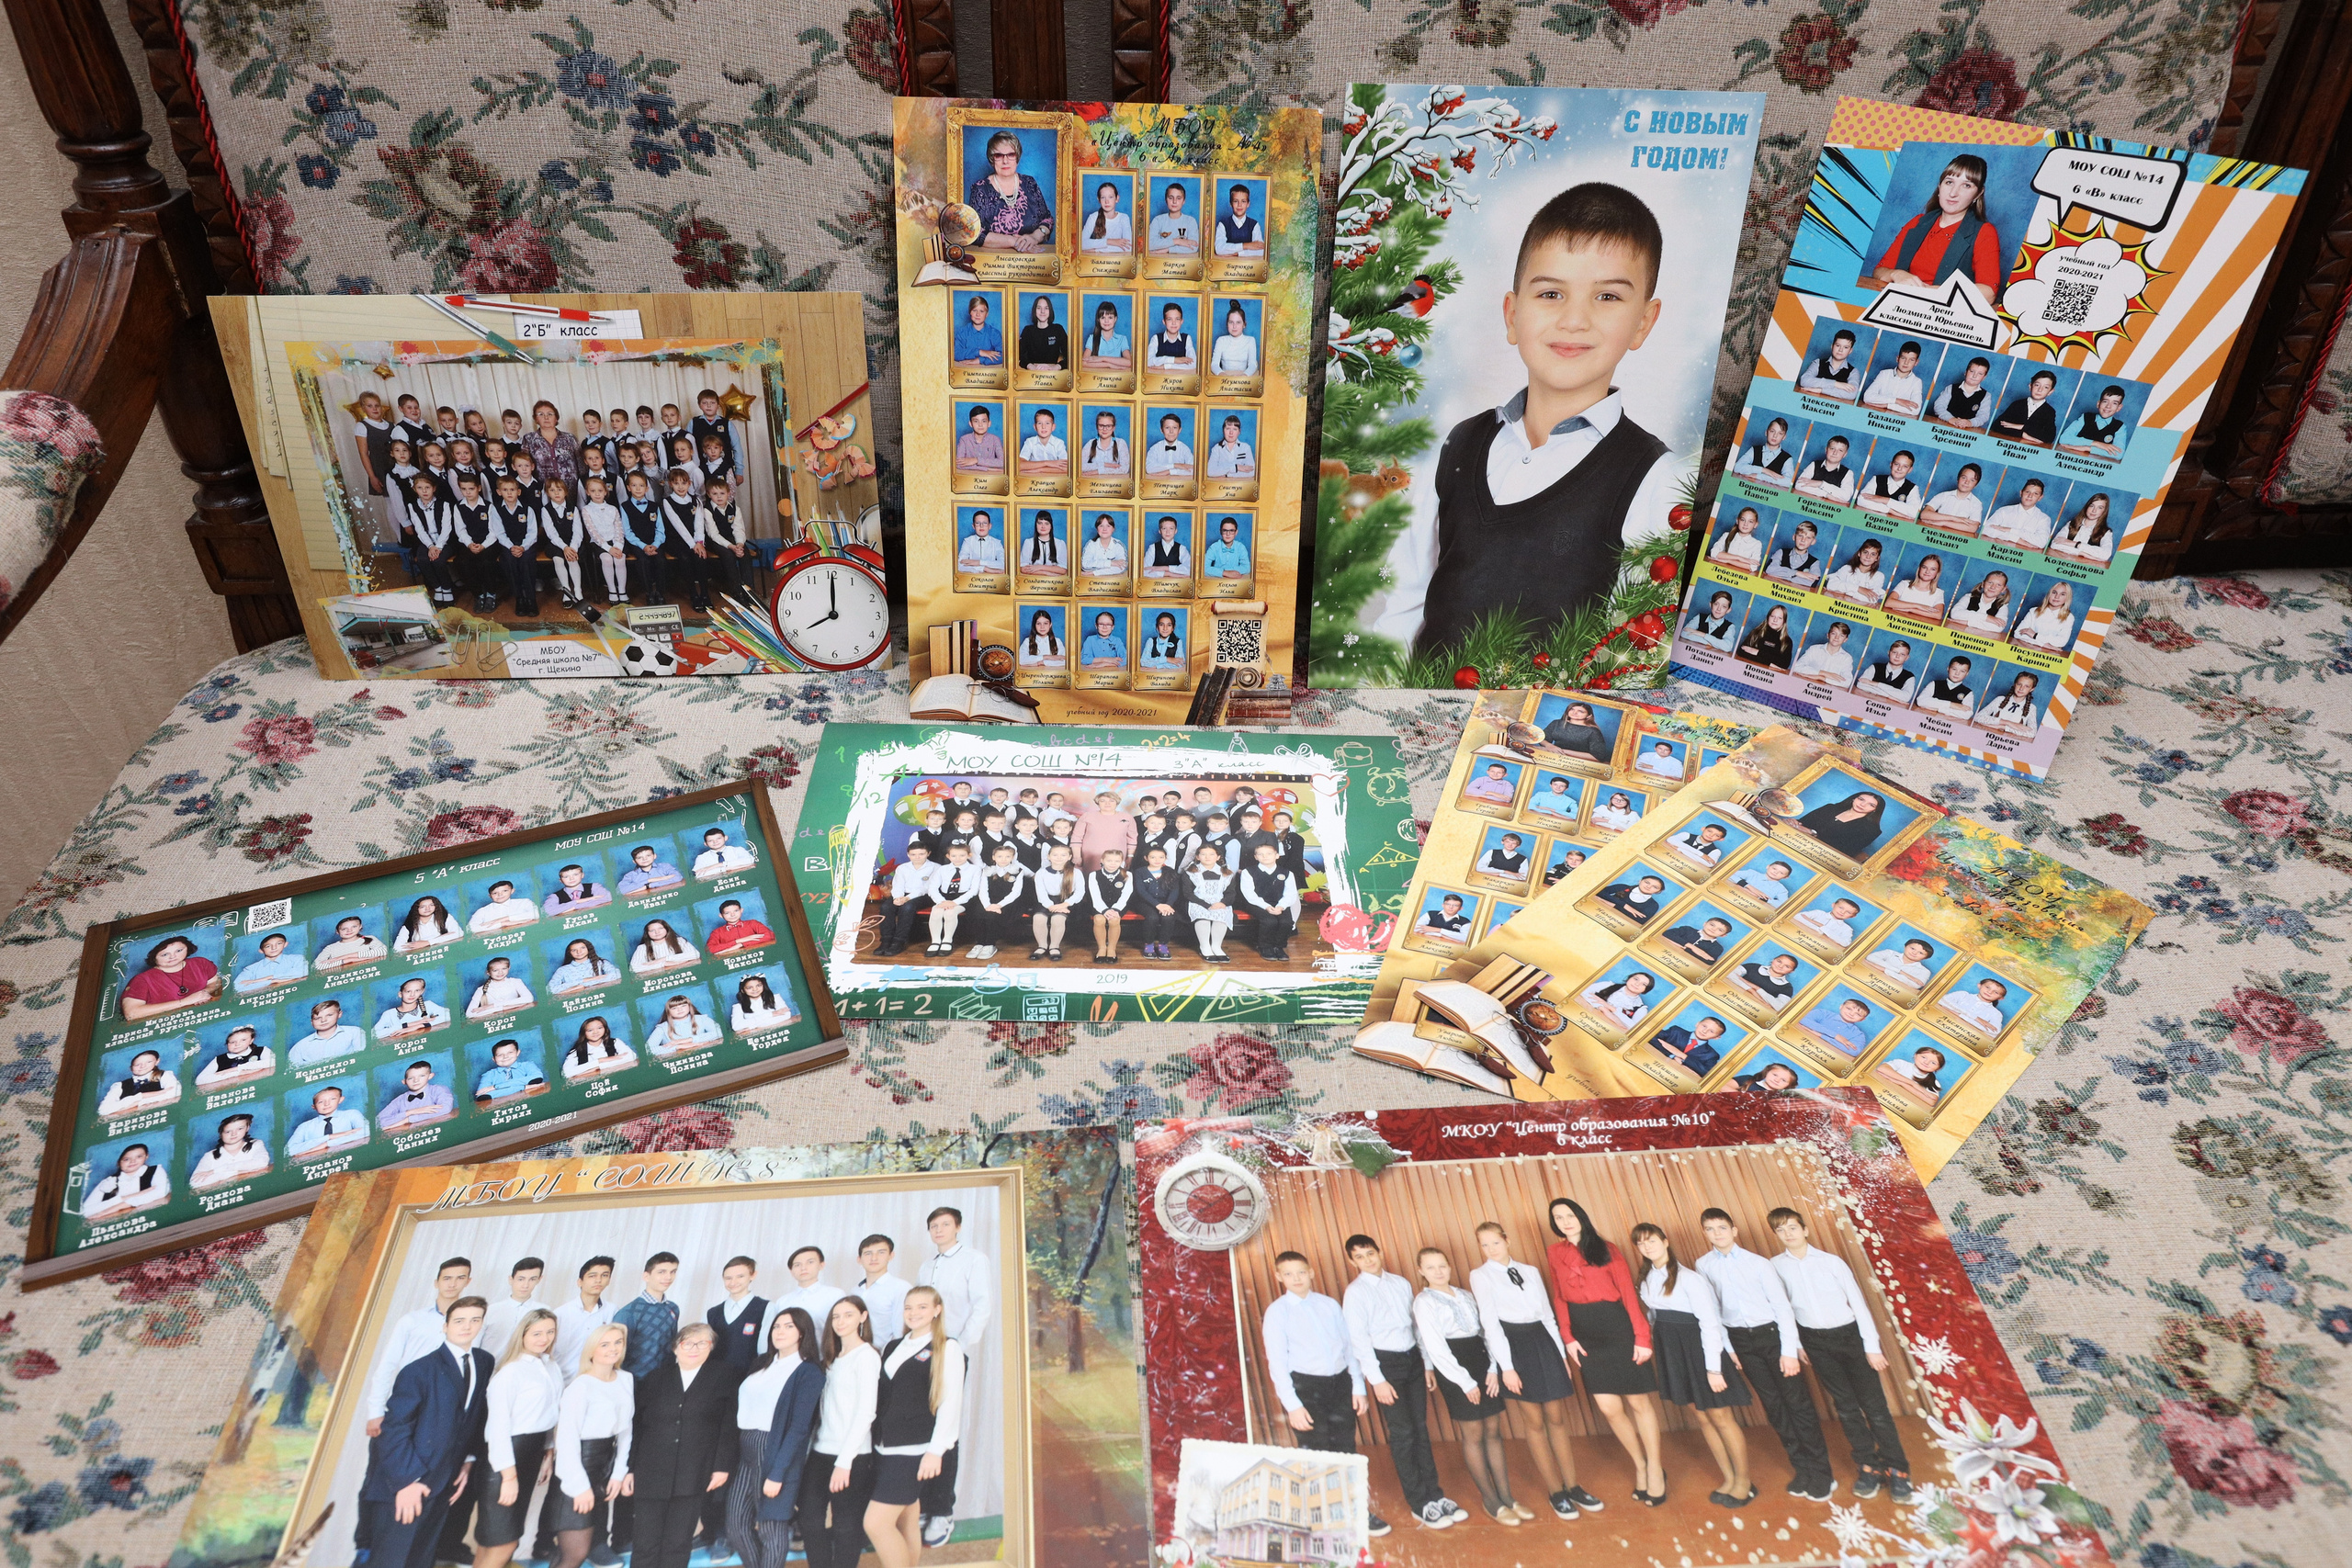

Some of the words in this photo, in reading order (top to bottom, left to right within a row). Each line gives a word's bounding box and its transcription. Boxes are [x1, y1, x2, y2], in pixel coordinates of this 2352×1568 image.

[1147, 117, 1216, 135] МБОУ
[1624, 110, 1640, 132] С
[1649, 111, 1748, 135] НОВЫМ
[1148, 136, 1222, 152] образования
[1139, 152, 1146, 163] 6
[1631, 146, 1728, 171] ГОДОМ!
[2069, 161, 2097, 173] МОУ
[2100, 165, 2131, 179] СОШ
[2133, 171, 2164, 185] №14
[2073, 185, 2081, 194] 6
[2086, 187, 2106, 198] «В»
[2109, 193, 2143, 205] класс
[2060, 255, 2095, 266] учебный
[2097, 262, 2111, 270] год
[2058, 265, 2104, 280] 2020-2021
[1893, 305, 1932, 320] Людмила
[1935, 317, 1974, 331] Юрьевна
[1929, 305, 1954, 316] Арент
[560, 326, 597, 336] класс
[1879, 312, 1922, 327] классный
[1925, 324, 1984, 343] руководитель
[1801, 396, 1840, 410] Алексеев
[1802, 403, 1835, 416] Максим
[1868, 412, 1905, 425] Балашов
[1868, 420, 1901, 433] Никита
[1931, 426, 1977, 443] Барбашин
[1932, 434, 1971, 448] Арсений
[1996, 440, 2039, 455] Барыкин
[2003, 450, 2027, 460] Иван
[2055, 452, 2112, 470] Виндовский
[2056, 462, 2105, 478] Александр
[1738, 480, 1779, 497] Воронцов
[1744, 490, 1769, 502] Павел
[1797, 496, 1841, 513] Гореленко
[1800, 504, 1834, 519] Максим
[1864, 513, 1899, 527] Горелов
[1865, 522, 1893, 534] Вадим
[1921, 527, 1969, 544] Емельянов
[1926, 536, 1959, 549] Михаил
[1991, 544, 2024, 557] Карлов
[1986, 552, 2022, 565] Максим
[2044, 557, 2105, 576] Колесникова
[2056, 568, 2087, 580] Софья
[807, 576, 817, 584] 11
[850, 578, 854, 586] 1
[790, 592, 801, 600] 10
[869, 594, 875, 603] 2
[785, 609, 791, 617] 9
[876, 612, 881, 620] 3
[1884, 615, 1934, 631] Муковнина
[1886, 622, 1928, 637] Ангелина
[1951, 631, 1995, 648] Пименова
[1952, 639, 1986, 653] Марина
[540, 647, 566, 655] МБОУ
[831, 650, 838, 659] 6
[854, 646, 859, 654] 5
[2010, 646, 2063, 664] Посулихина
[548, 665, 582, 673] Щекино
[2017, 655, 2051, 669] Карина
[1742, 671, 1773, 684] Милана
[1746, 664, 1775, 678] Попова
[1803, 689, 1832, 702] Андрей
[1806, 682, 1833, 695] Савин
[1067, 706, 1095, 717] учебный
[1098, 709, 1109, 717] год
[1112, 708, 1158, 716] 2020-2021
[1919, 722, 1952, 736] Максим
[1926, 716, 1951, 728] Чебан
[1985, 732, 2020, 747] Юрьева
[1985, 740, 2014, 752] Дарья
[946, 755, 998, 769] МОУ
[1012, 754, 1060, 768] СОШ
[1075, 752, 1122, 767] №14
[1217, 760, 1265, 768] класс
[555, 836, 582, 852] МОУ
[586, 830, 613, 844] СОШ
[616, 822, 646, 836] №14
[414, 873, 425, 884] 5
[459, 857, 501, 874] класс
[713, 879, 747, 893] Данила
[718, 875, 740, 886] Есин
[723, 951, 764, 965] Новиков
[728, 956, 763, 970] Максим
[643, 976, 697, 993] Елизавета
[644, 971, 693, 987] Морозова
[1097, 974, 1127, 984] 2019
[239, 986, 298, 1006] Антоненко
[253, 995, 285, 1008] Тимур
[105, 1032, 153, 1049] классный
[160, 1010, 232, 1034] руководитель
[112, 1028, 149, 1042] Лариса
[154, 1008, 220, 1030] Анатольевна
[394, 1037, 427, 1051] Короп
[398, 1044, 424, 1056] Анна
[662, 1050, 714, 1070] Чижикова
[670, 1059, 708, 1075] Полина
[584, 1083, 618, 1099] София
[591, 1077, 610, 1090] Цой
[206, 1092, 255, 1110] Валерия
[207, 1086, 255, 1102] Иванова
[492, 1108, 532, 1126] Кирилл
[494, 1102, 528, 1118] Титов
[528, 1111, 578, 1133] 2020-2021
[1442, 1122, 1503, 1138] МКОУ
[1571, 1117, 1668, 1135] образования
[393, 1126, 441, 1145] Соболев
[1556, 1133, 1566, 1146] 6
[1571, 1134, 1612, 1148] класс
[397, 1135, 438, 1153] Даниил
[417, 1171, 563, 1213] МБОУ
[92, 1215, 146, 1236] Пьянова
[78, 1220, 157, 1249] Александра
